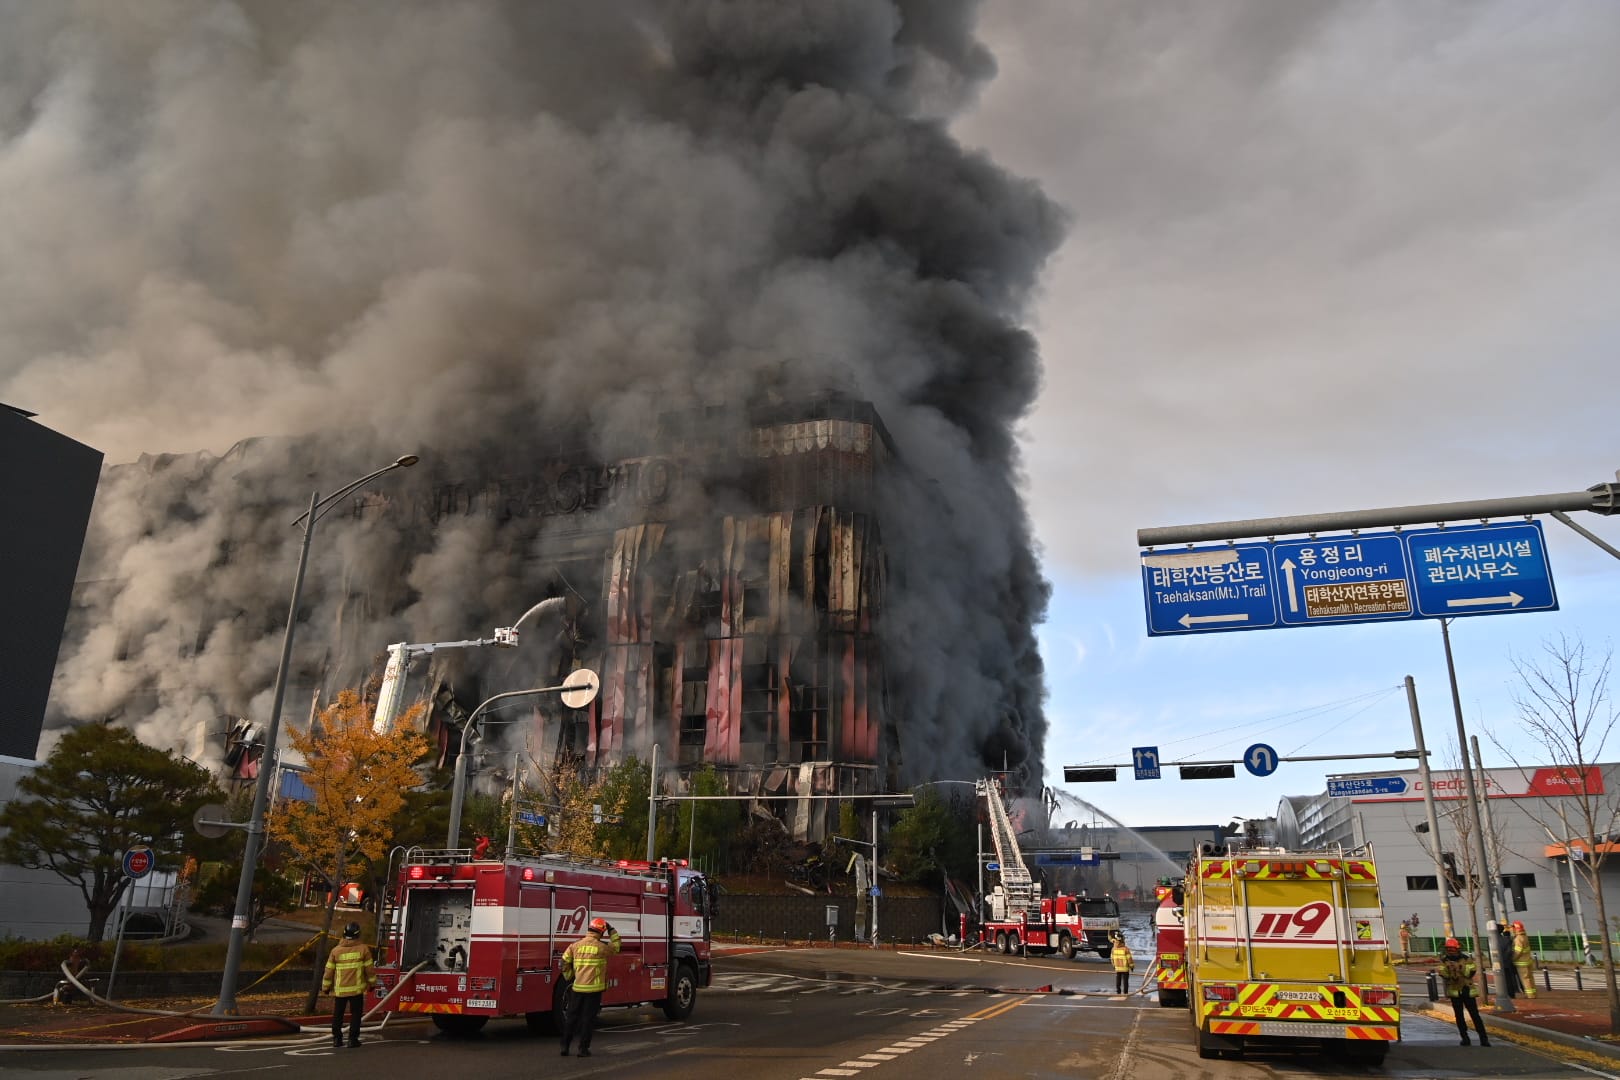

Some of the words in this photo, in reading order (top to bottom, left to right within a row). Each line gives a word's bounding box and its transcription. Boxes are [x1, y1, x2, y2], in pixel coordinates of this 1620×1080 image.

[1423, 540, 1533, 564] 폐수처리시설
[1153, 562, 1264, 588] 태학산등산로
[1301, 563, 1389, 581] Yongjeong-ri
[1427, 562, 1519, 583] 관리사무소
[1155, 585, 1240, 604] Taehaksan(Mt.)
[1241, 584, 1267, 598] Trail
[1307, 581, 1407, 603] 태학산자연휴양림
[1354, 601, 1386, 613] Recreation
[1387, 599, 1408, 611] Forest
[556, 905, 588, 934] 119
[1253, 902, 1331, 939] 119
[1242, 1005, 1274, 1014] 경기도소방
[1327, 1008, 1360, 1017] 오산25호
